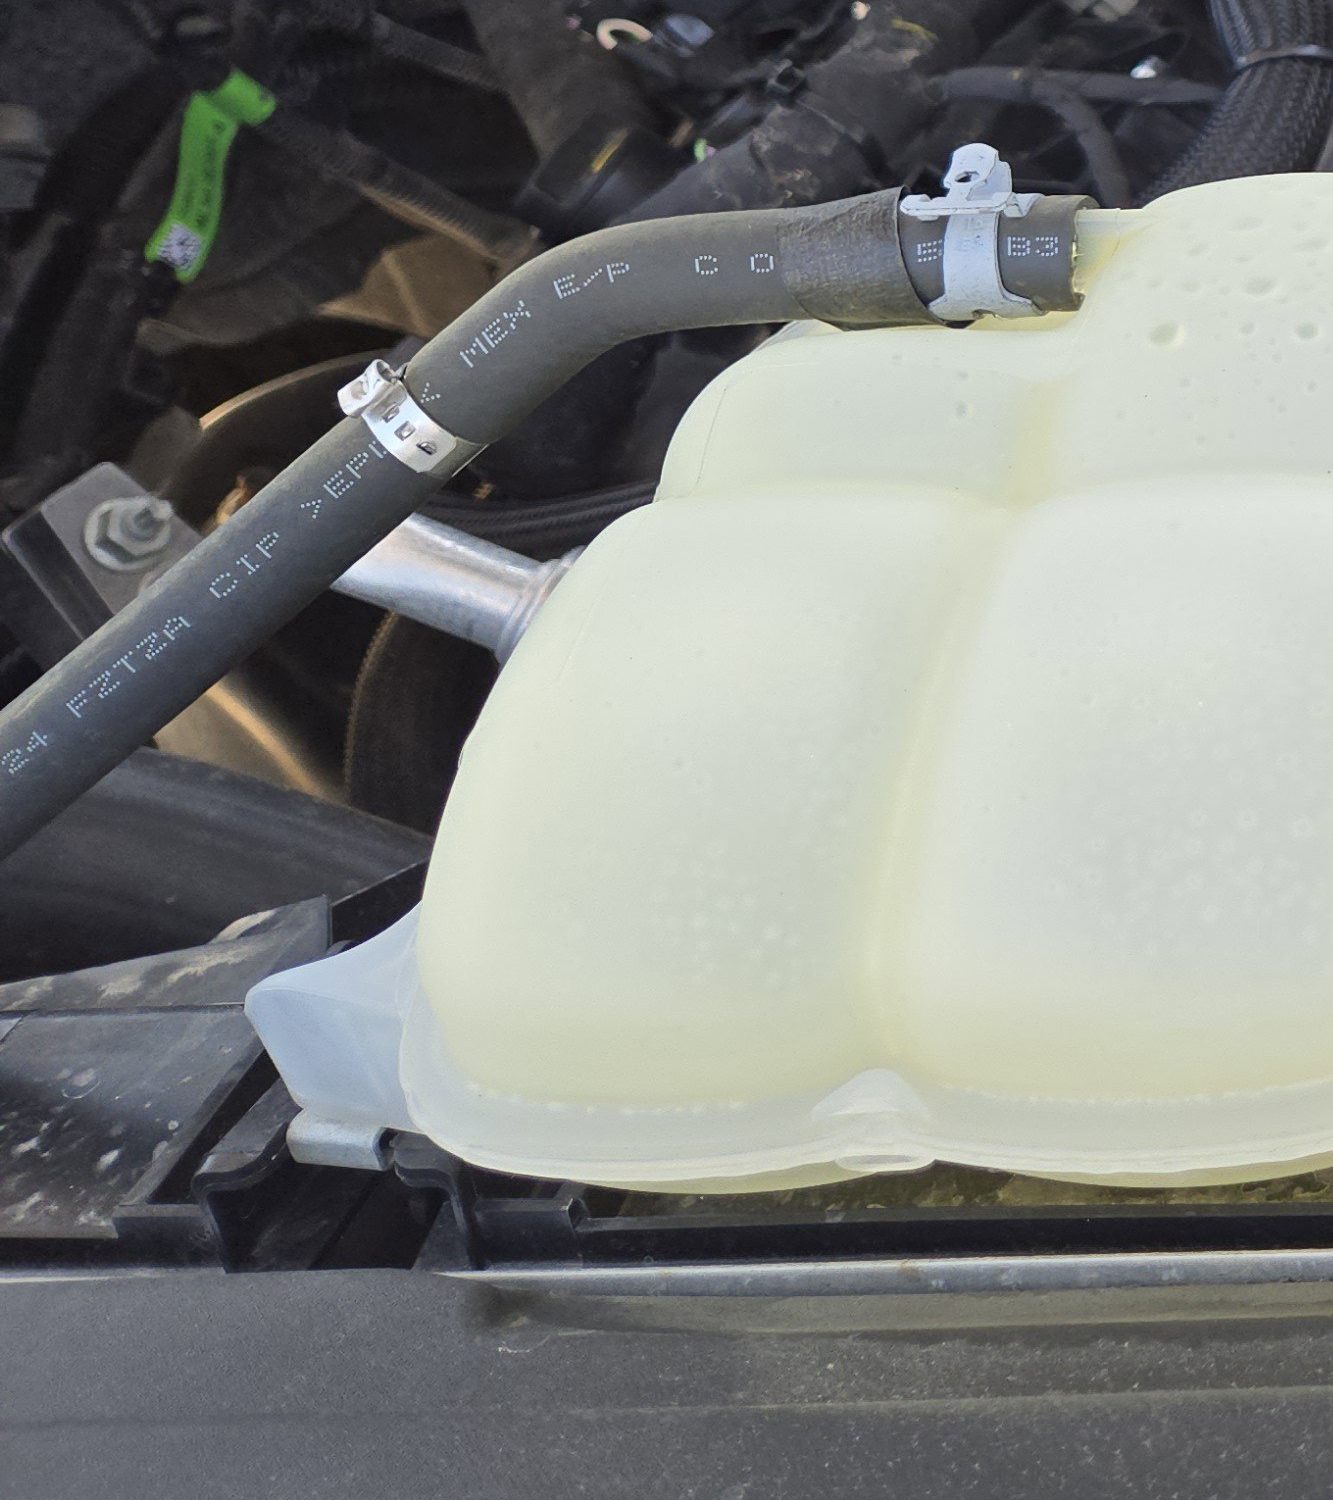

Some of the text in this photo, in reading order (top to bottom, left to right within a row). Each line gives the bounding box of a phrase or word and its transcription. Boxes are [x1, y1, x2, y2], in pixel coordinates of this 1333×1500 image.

[66, 615, 192, 719] FZTZA
[209, 531, 280, 599] CIP
[459, 299, 532, 368] MEX
[553, 261, 630, 300] E/P
[1007, 236, 1059, 257] B3
